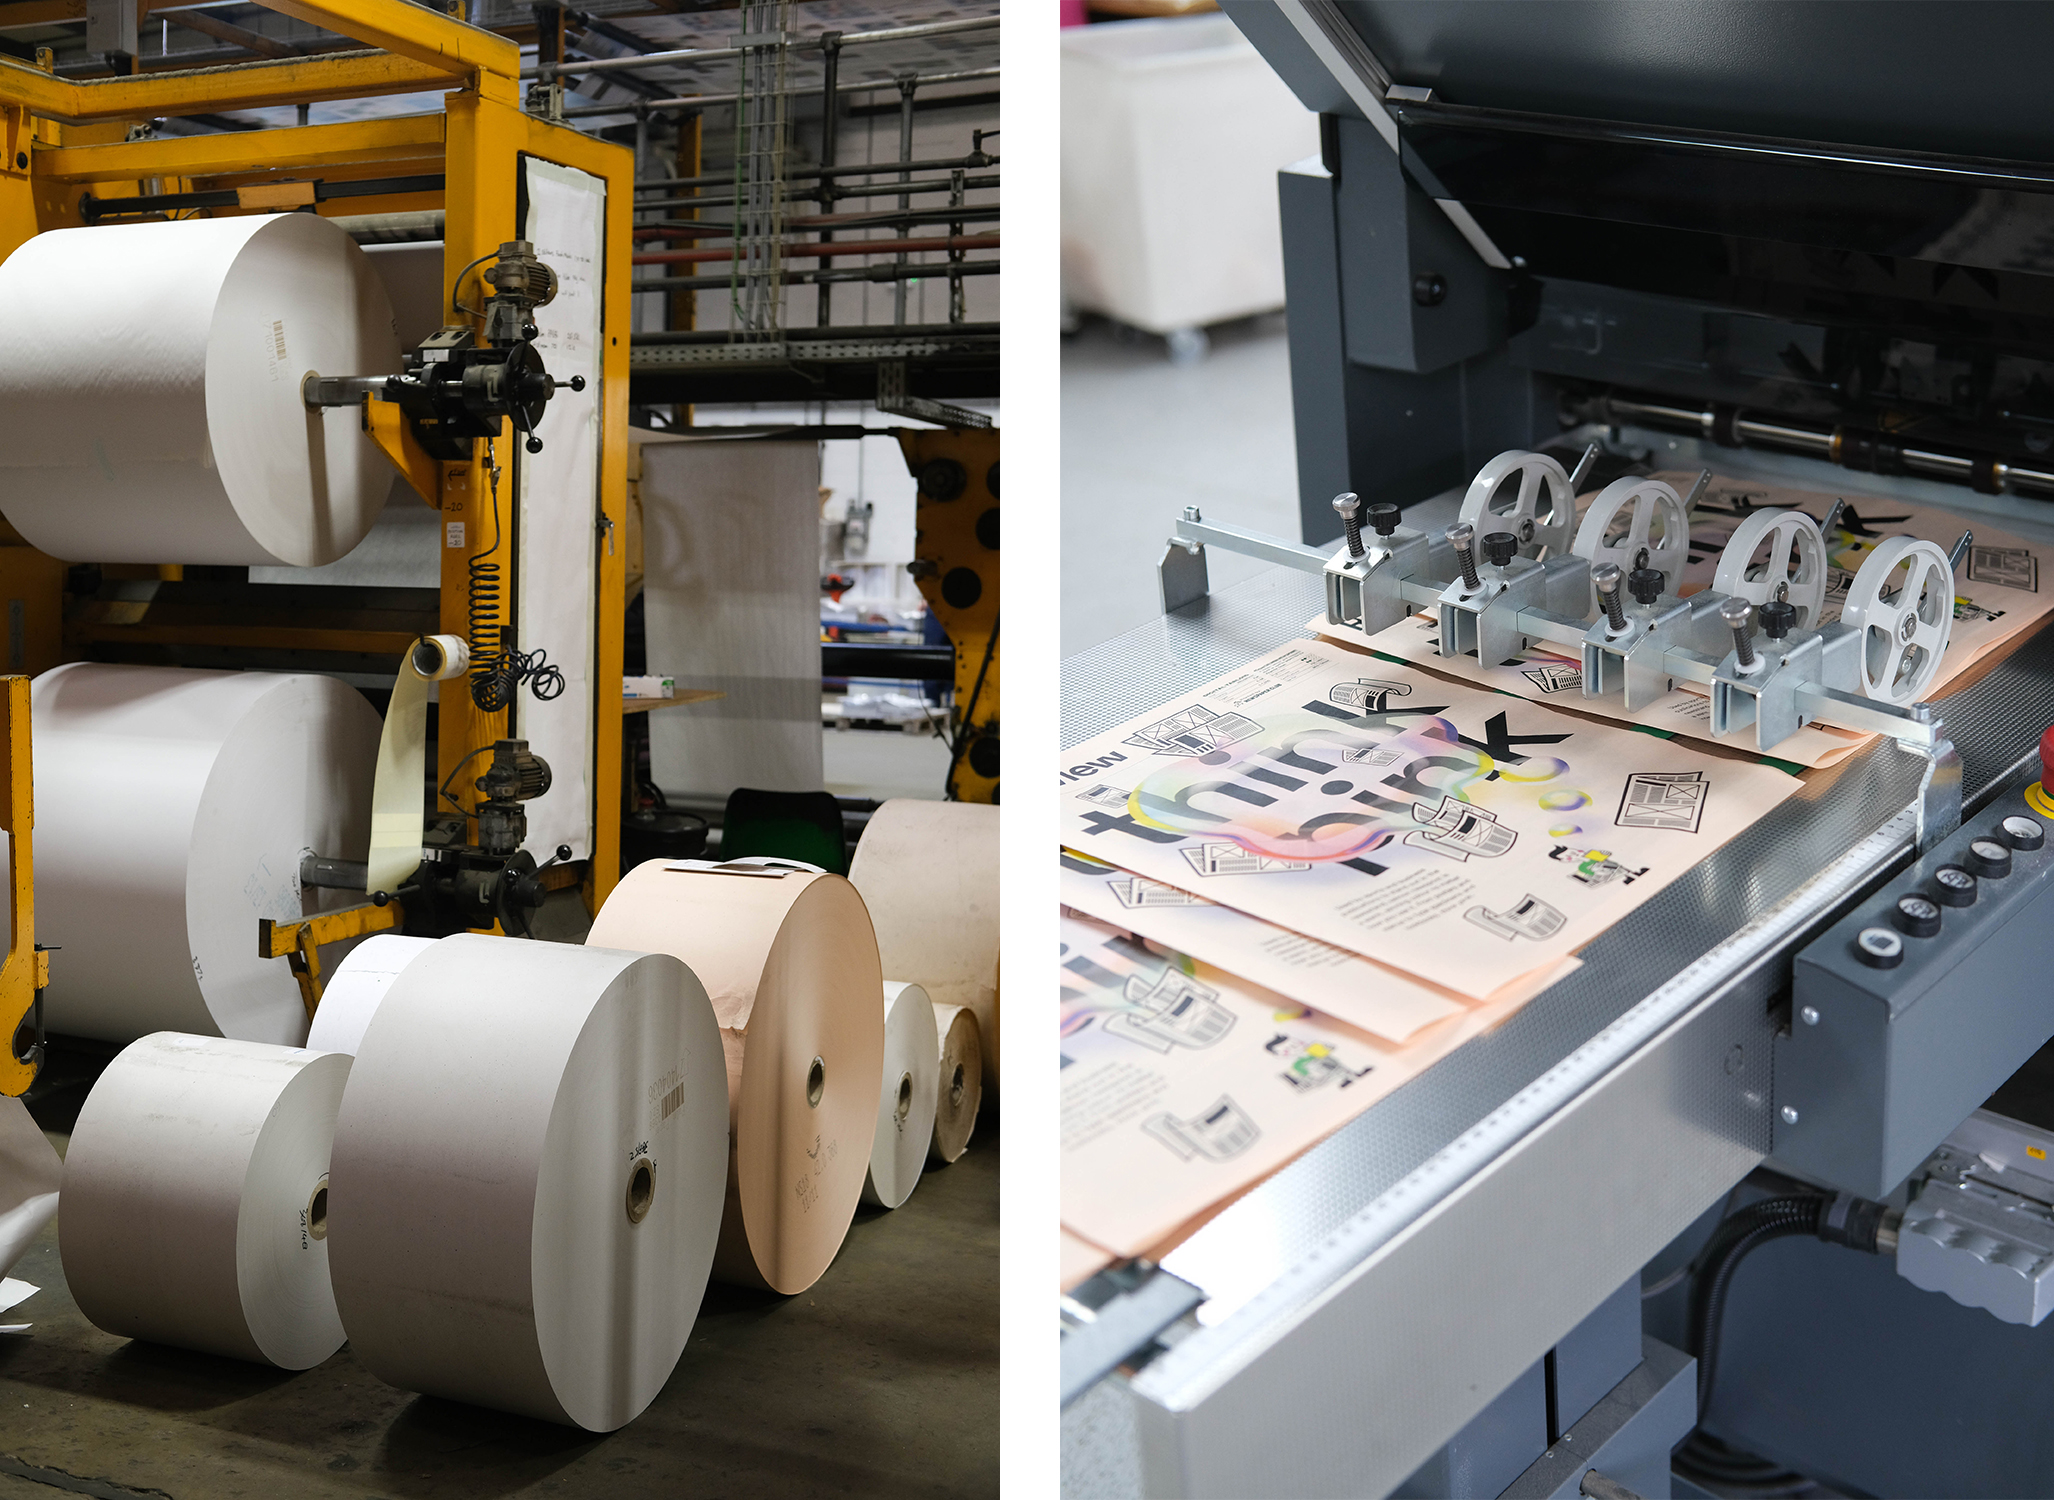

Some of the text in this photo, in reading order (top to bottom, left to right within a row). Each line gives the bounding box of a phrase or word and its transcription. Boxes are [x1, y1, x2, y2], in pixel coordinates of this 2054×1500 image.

[1060, 750, 1128, 787] iew
[1079, 699, 1451, 844] think
[1276, 710, 1574, 877] pink
